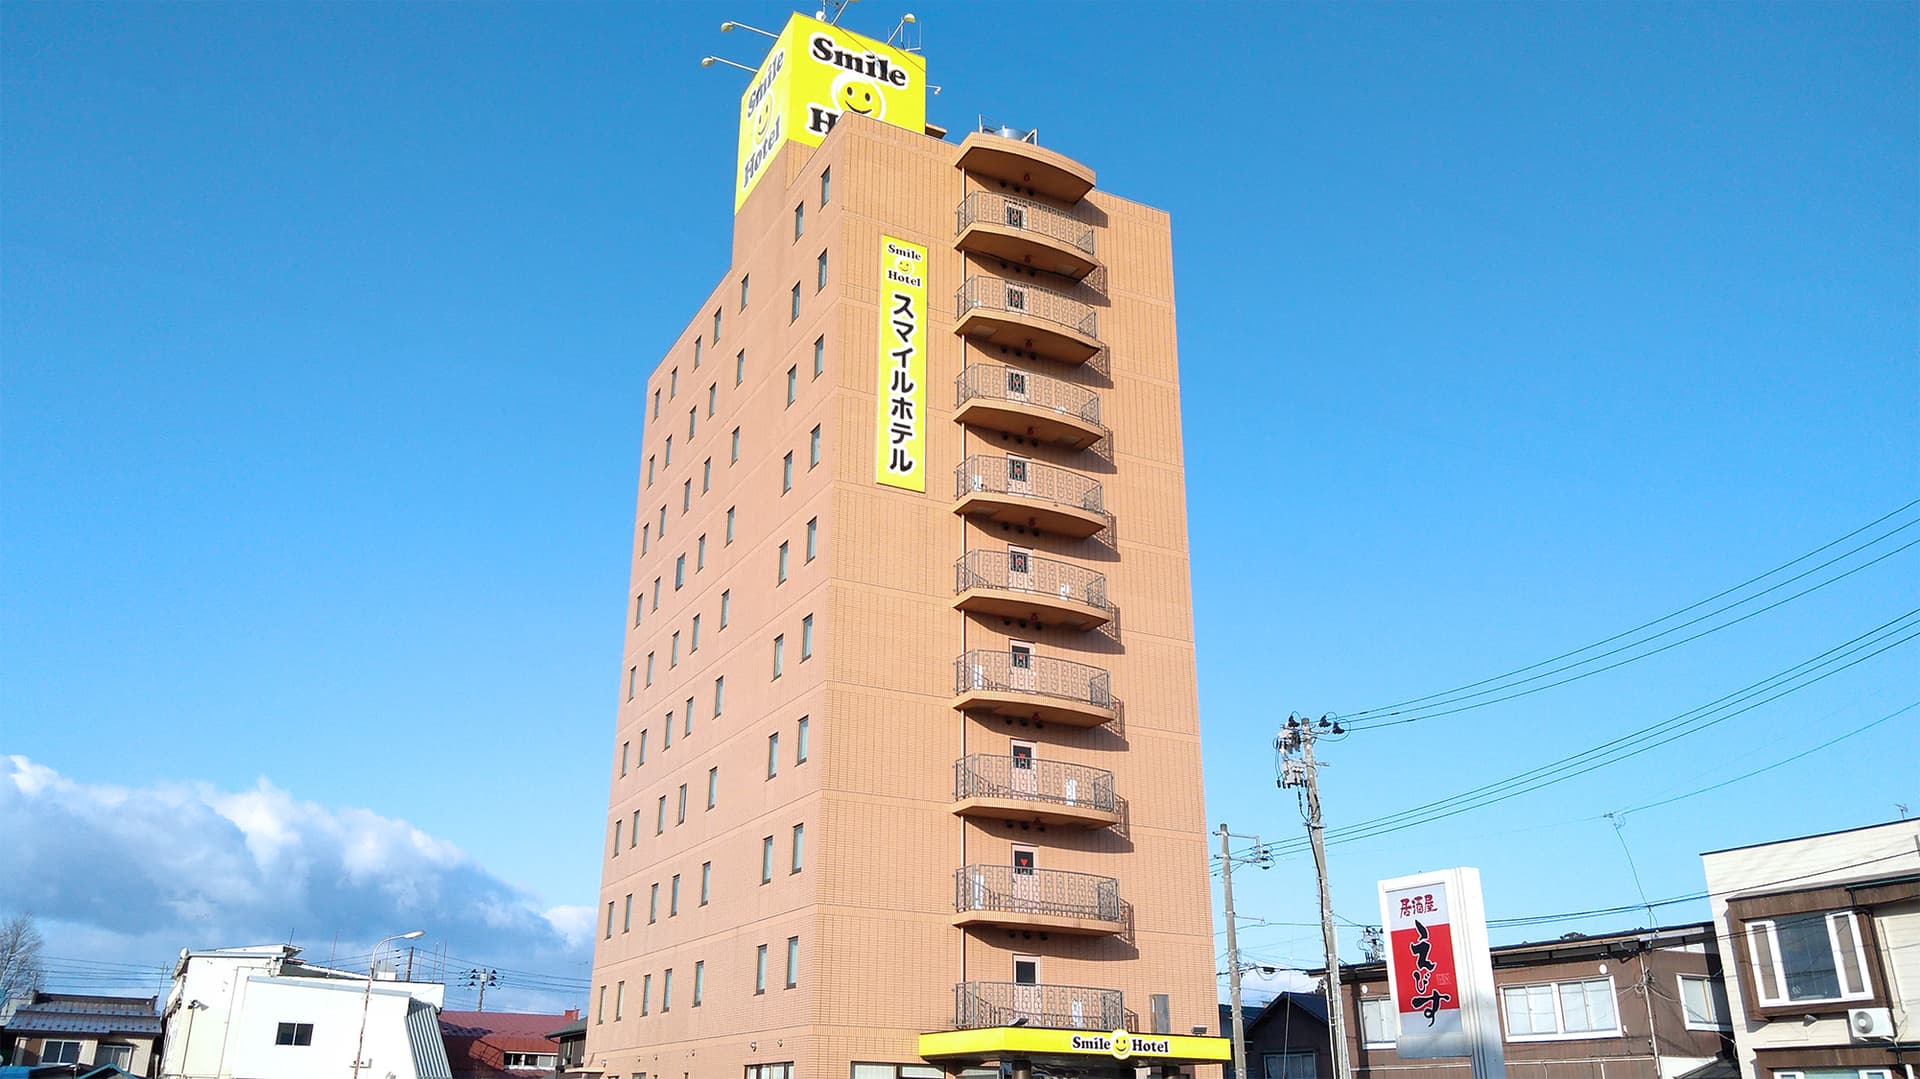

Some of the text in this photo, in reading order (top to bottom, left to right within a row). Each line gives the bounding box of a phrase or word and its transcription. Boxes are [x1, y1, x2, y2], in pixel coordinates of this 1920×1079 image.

[812, 36, 906, 87] Smile
[747, 50, 785, 117] Smile
[743, 114, 781, 188] Hotel
[887, 244, 922, 261] Smile
[887, 270, 922, 287] Hotel
[889, 293, 915, 473] スマイルホテル
[1399, 894, 1438, 918] 居酒屋
[1072, 1036, 1169, 1053] Smile Hotel
